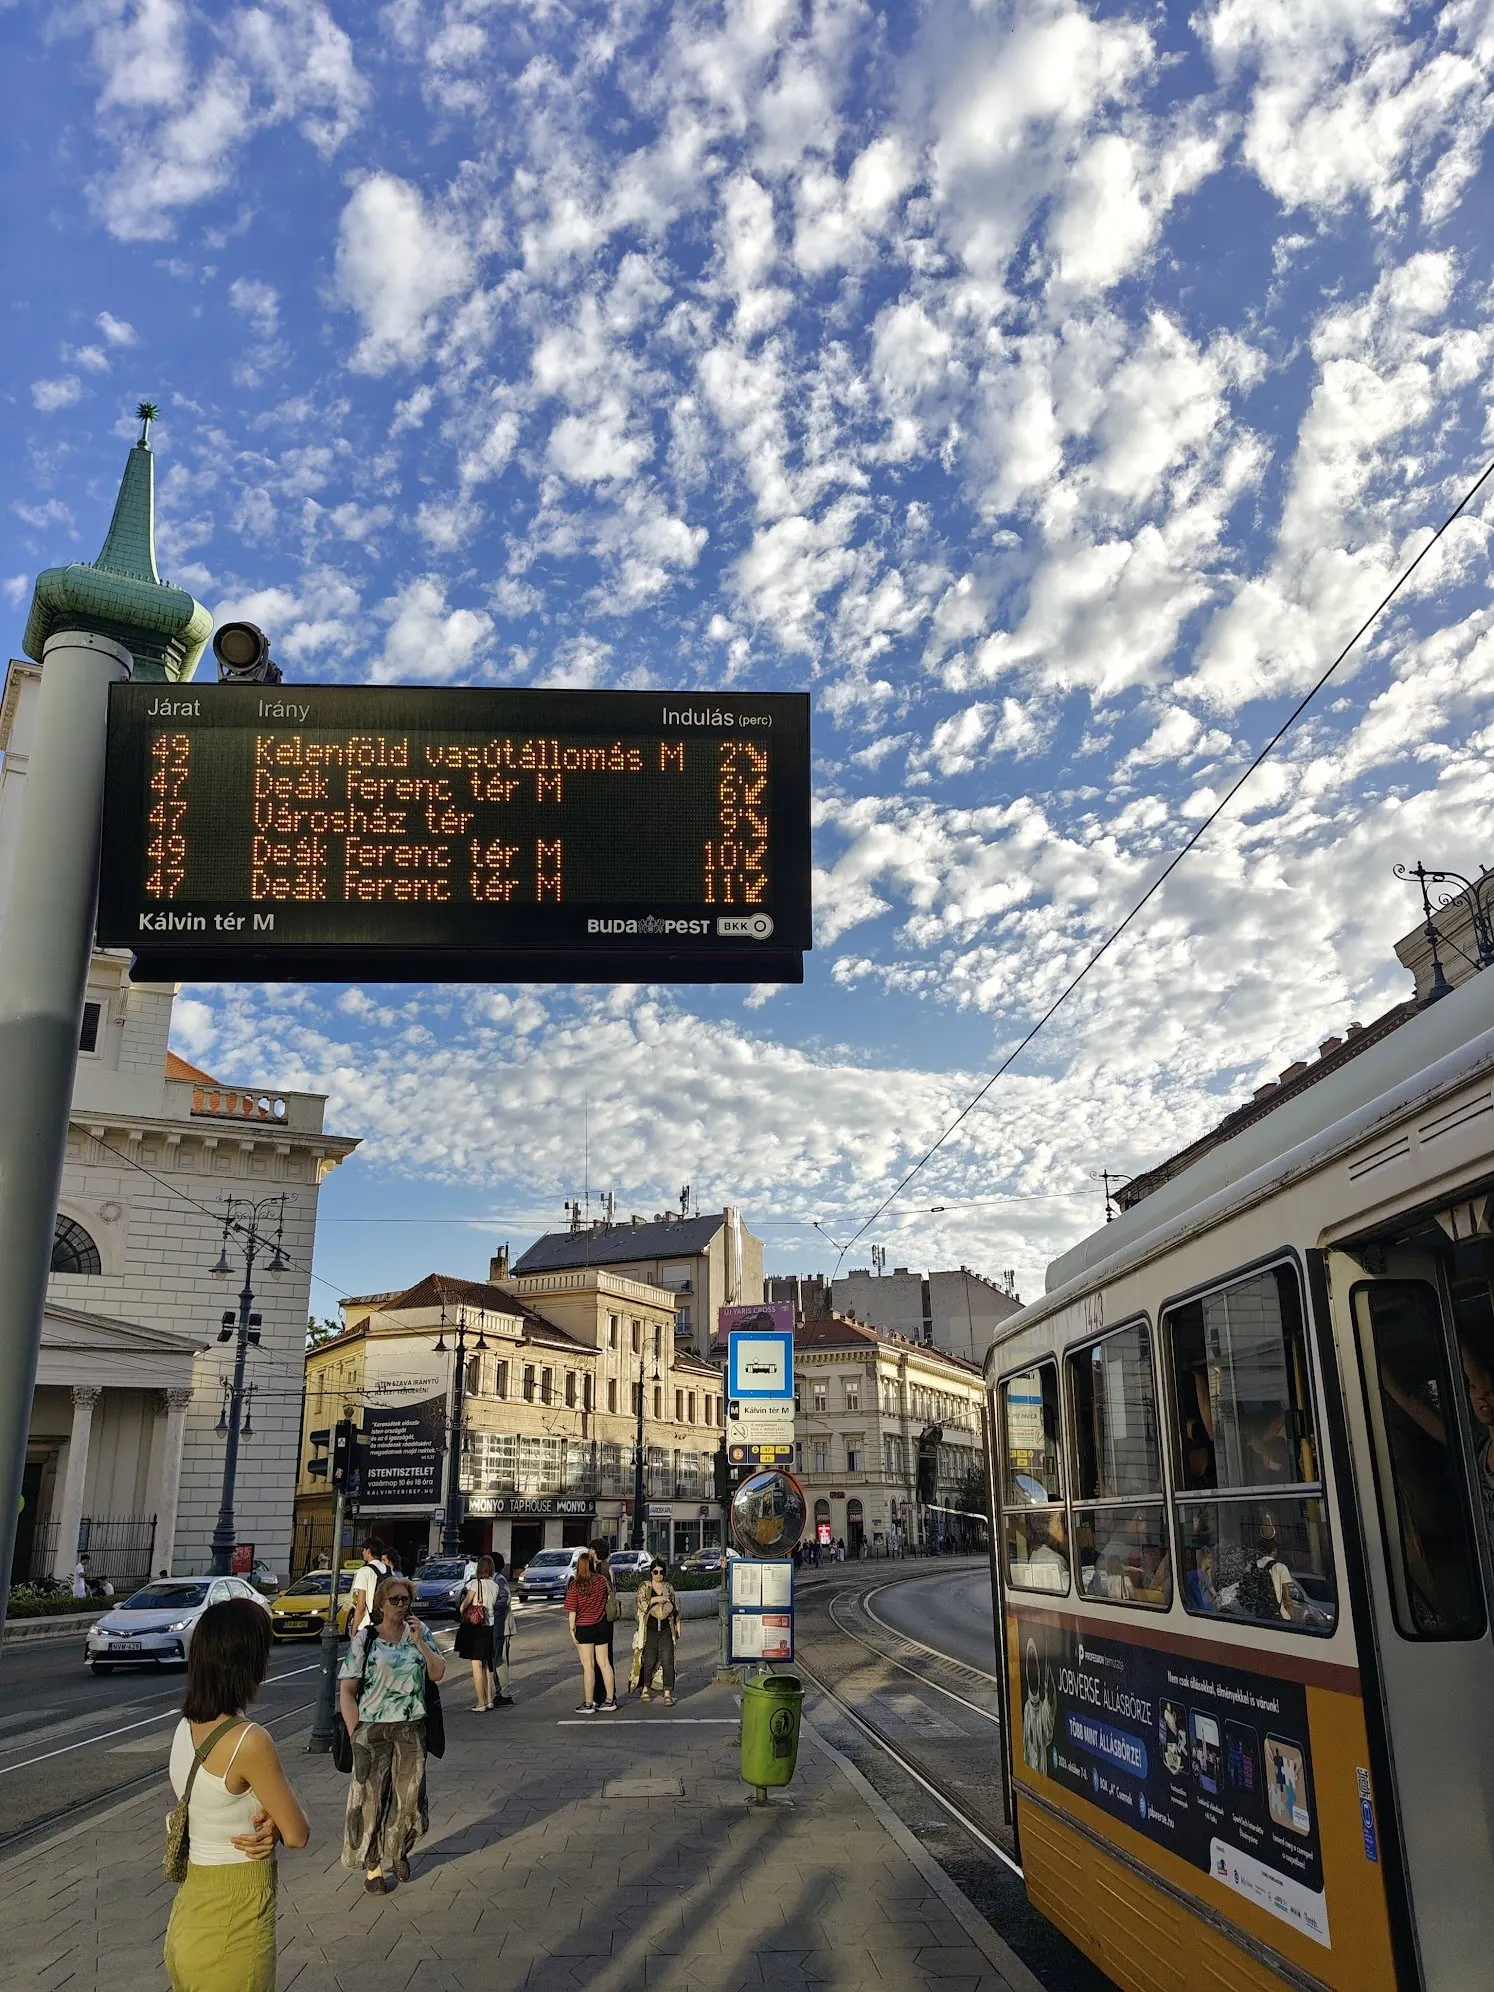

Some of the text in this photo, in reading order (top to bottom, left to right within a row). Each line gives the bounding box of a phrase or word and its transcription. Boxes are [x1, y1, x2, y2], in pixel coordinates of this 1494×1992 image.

[147, 698, 201, 716] Járat
[258, 700, 311, 721] Irány
[662, 707, 772, 727] Indulás (perc)
[152, 734, 190, 764] 49
[255, 735, 408, 767] Kelenföld
[425, 739, 643, 771] vasútállomás
[660, 742, 684, 771] M
[150, 768, 189, 797] 47
[255, 769, 329, 798] Deák
[347, 770, 452, 800] Ferenc
[471, 772, 520, 802] tér
[537, 773, 561, 802] M
[149, 801, 188, 831] 47
[254, 802, 407, 834] Városház
[425, 804, 474, 834] tér
[148, 835, 186, 865] 49
[252, 836, 328, 866] Deák
[346, 837, 452, 867] Ferenc
[470, 838, 520, 868] tér
[537, 839, 561, 868] M
[146, 869, 185, 899] 47
[251, 869, 327, 900] Deák
[345, 871, 451, 901] Ferenc
[469, 872, 520, 901] tér
[537, 872, 561, 901] M
[138, 913, 275, 931] Kálvin tér M
[724, 922, 748, 932] BKK
[733, 1307, 752, 1316] YARIS
[753, 1305, 776, 1314] CROSS
[392, 1379, 412, 1387] SZAVA
[744, 1406, 766, 1414] Kálvin
[368, 1467, 435, 1477] ISTENTISZTELET
[368, 1480, 398, 1488] vasárnap
[1058, 1667, 1153, 1726] JOBVERSE ÁLLÁSBÖRZE
[1167, 1670, 1178, 1684] Nem
[1256, 1696, 1280, 1713] várunk!
[1069, 1717, 1142, 1768] TÖBB MINT ÁLLÁSBÖRZE!
